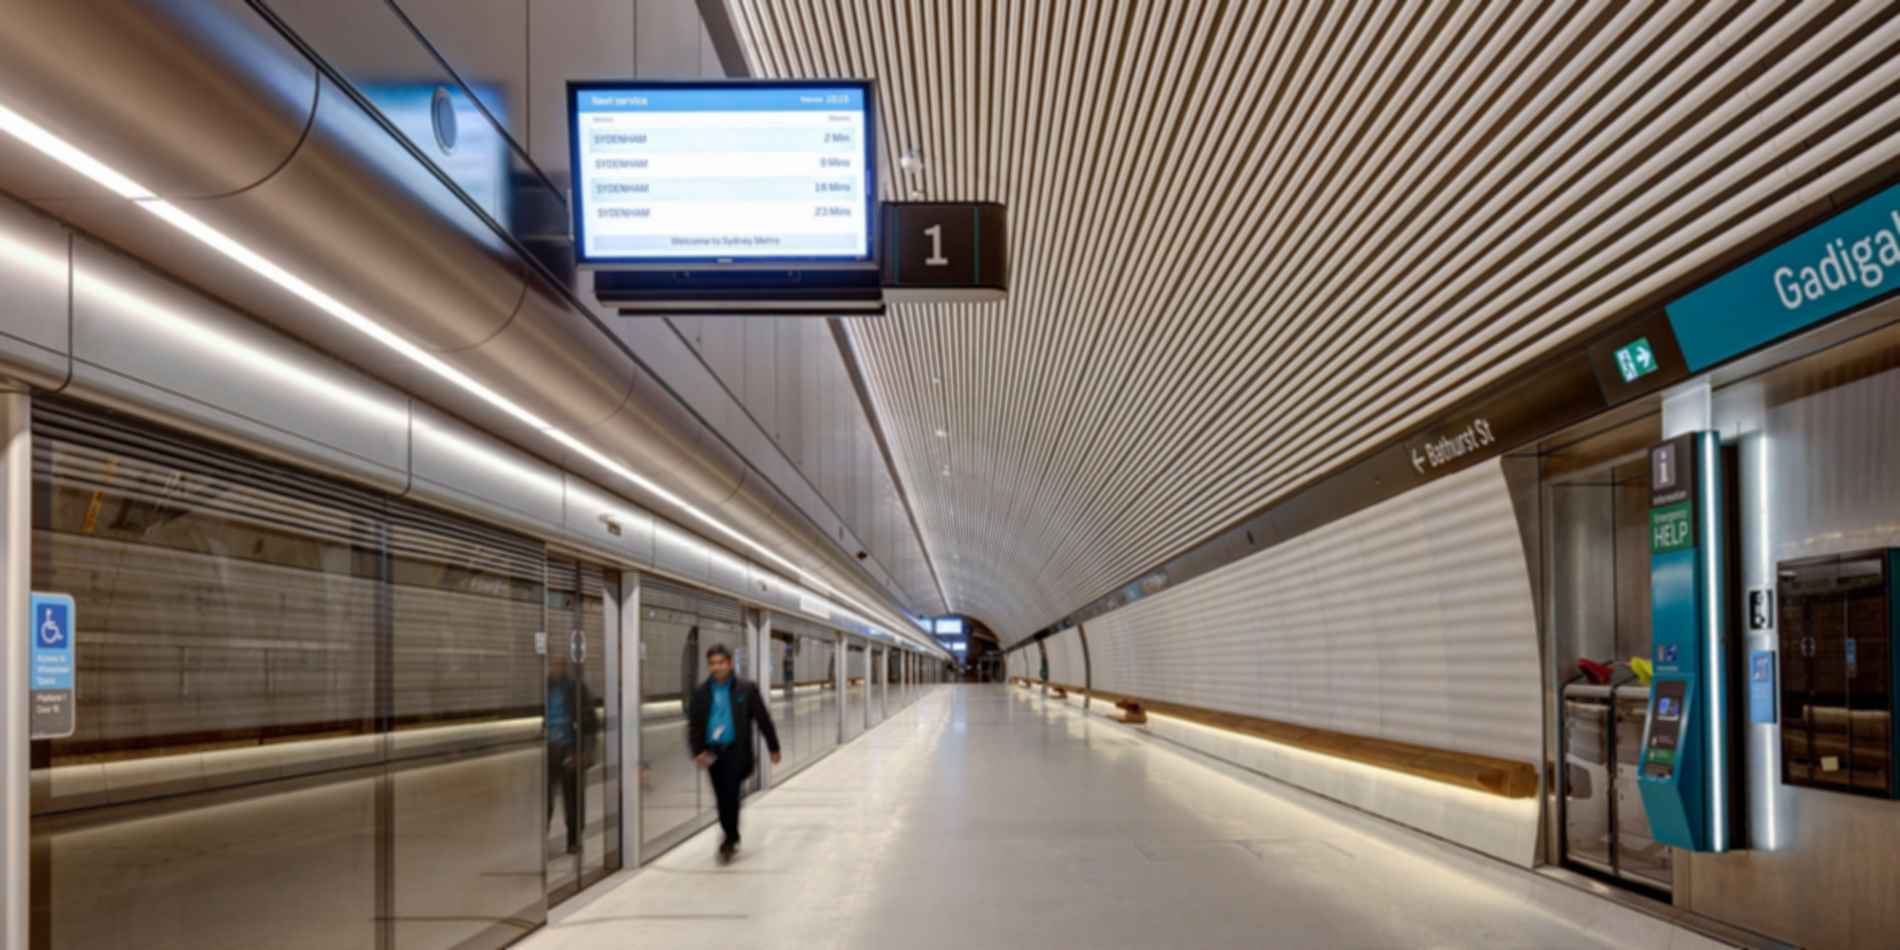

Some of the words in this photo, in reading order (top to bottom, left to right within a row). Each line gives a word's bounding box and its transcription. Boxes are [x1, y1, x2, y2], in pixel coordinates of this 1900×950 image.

[594, 133, 648, 144] SYDENHAM
[595, 159, 649, 169] SYDENHAM
[596, 183, 650, 194] SYDENHAM
[597, 208, 651, 218] SYDENHAM
[924, 223, 949, 266] 1
[1425, 425, 1480, 467] Bathurst
[1474, 418, 1496, 446] St
[1654, 520, 1689, 549] HELP
